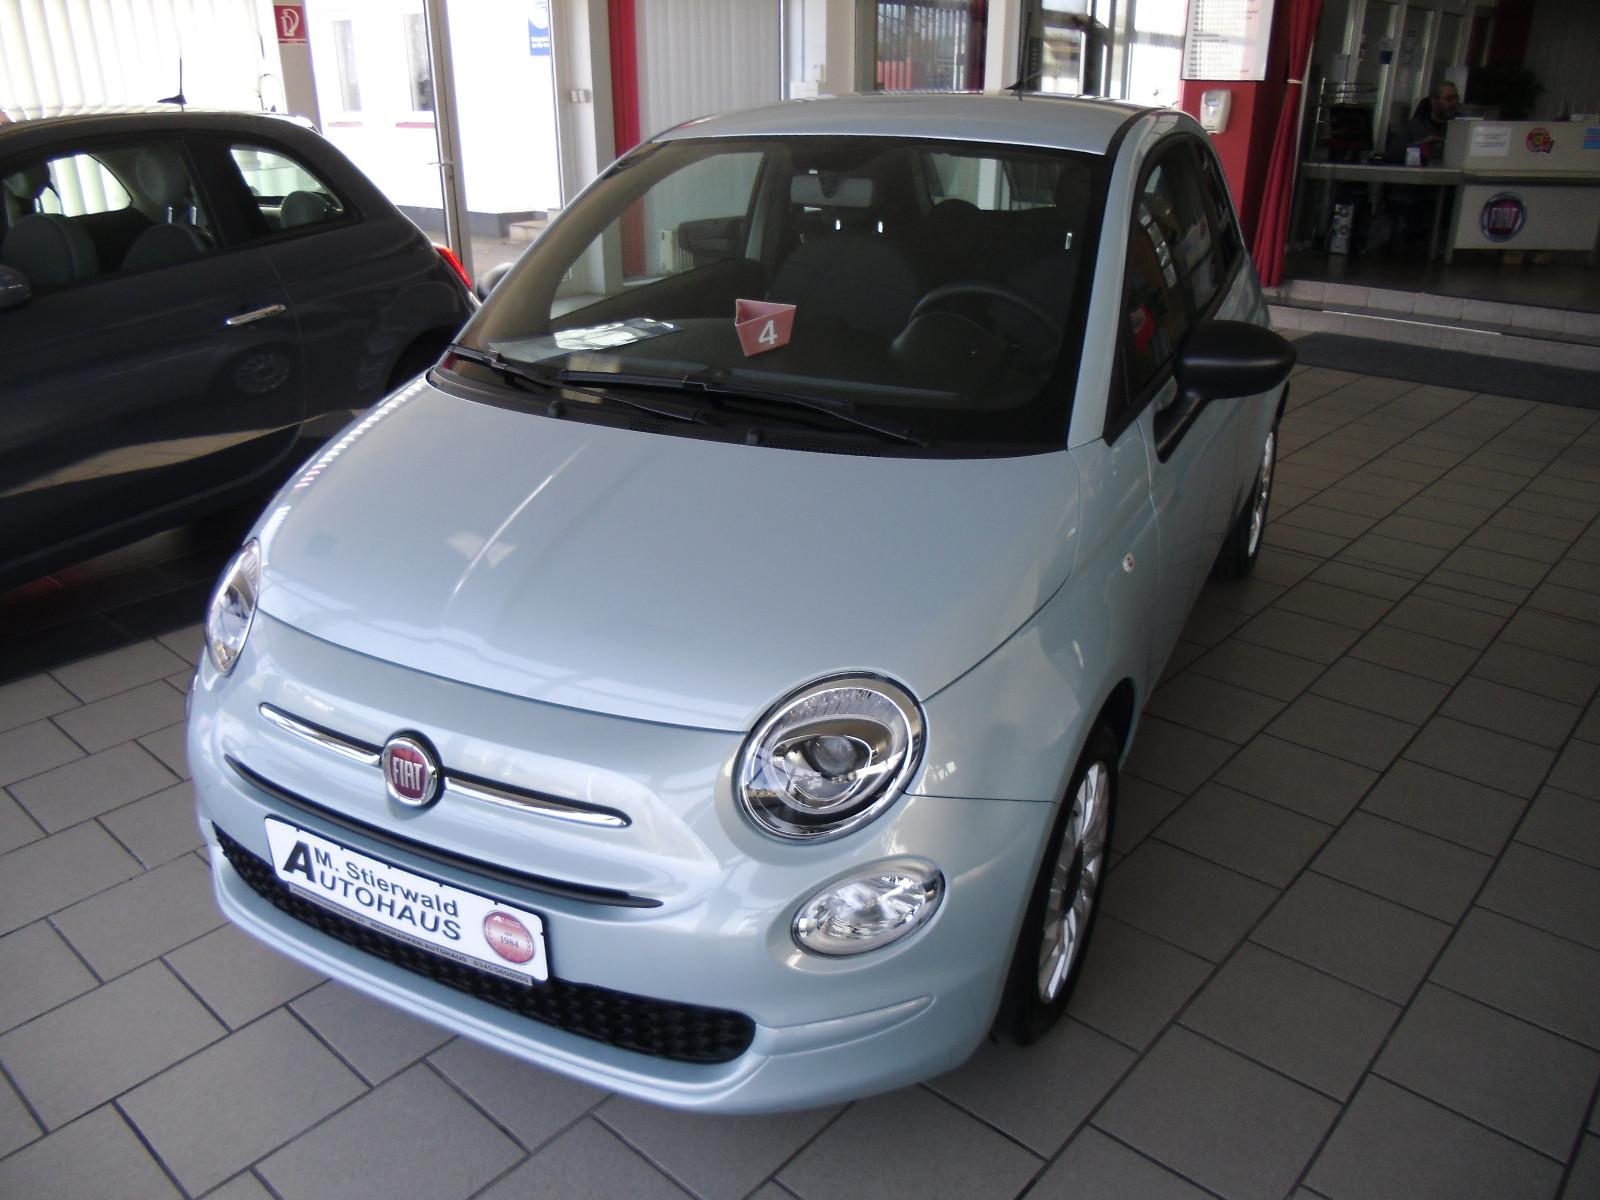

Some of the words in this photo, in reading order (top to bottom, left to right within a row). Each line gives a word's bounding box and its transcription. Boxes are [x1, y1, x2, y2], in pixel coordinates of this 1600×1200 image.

[758, 319, 778, 345] 4
[392, 756, 423, 791] FIAT
[282, 839, 461, 941] AUTOHAUS
[314, 846, 339, 873] M.
[345, 860, 459, 918] Stierwald
[500, 935, 519, 948] 1984
